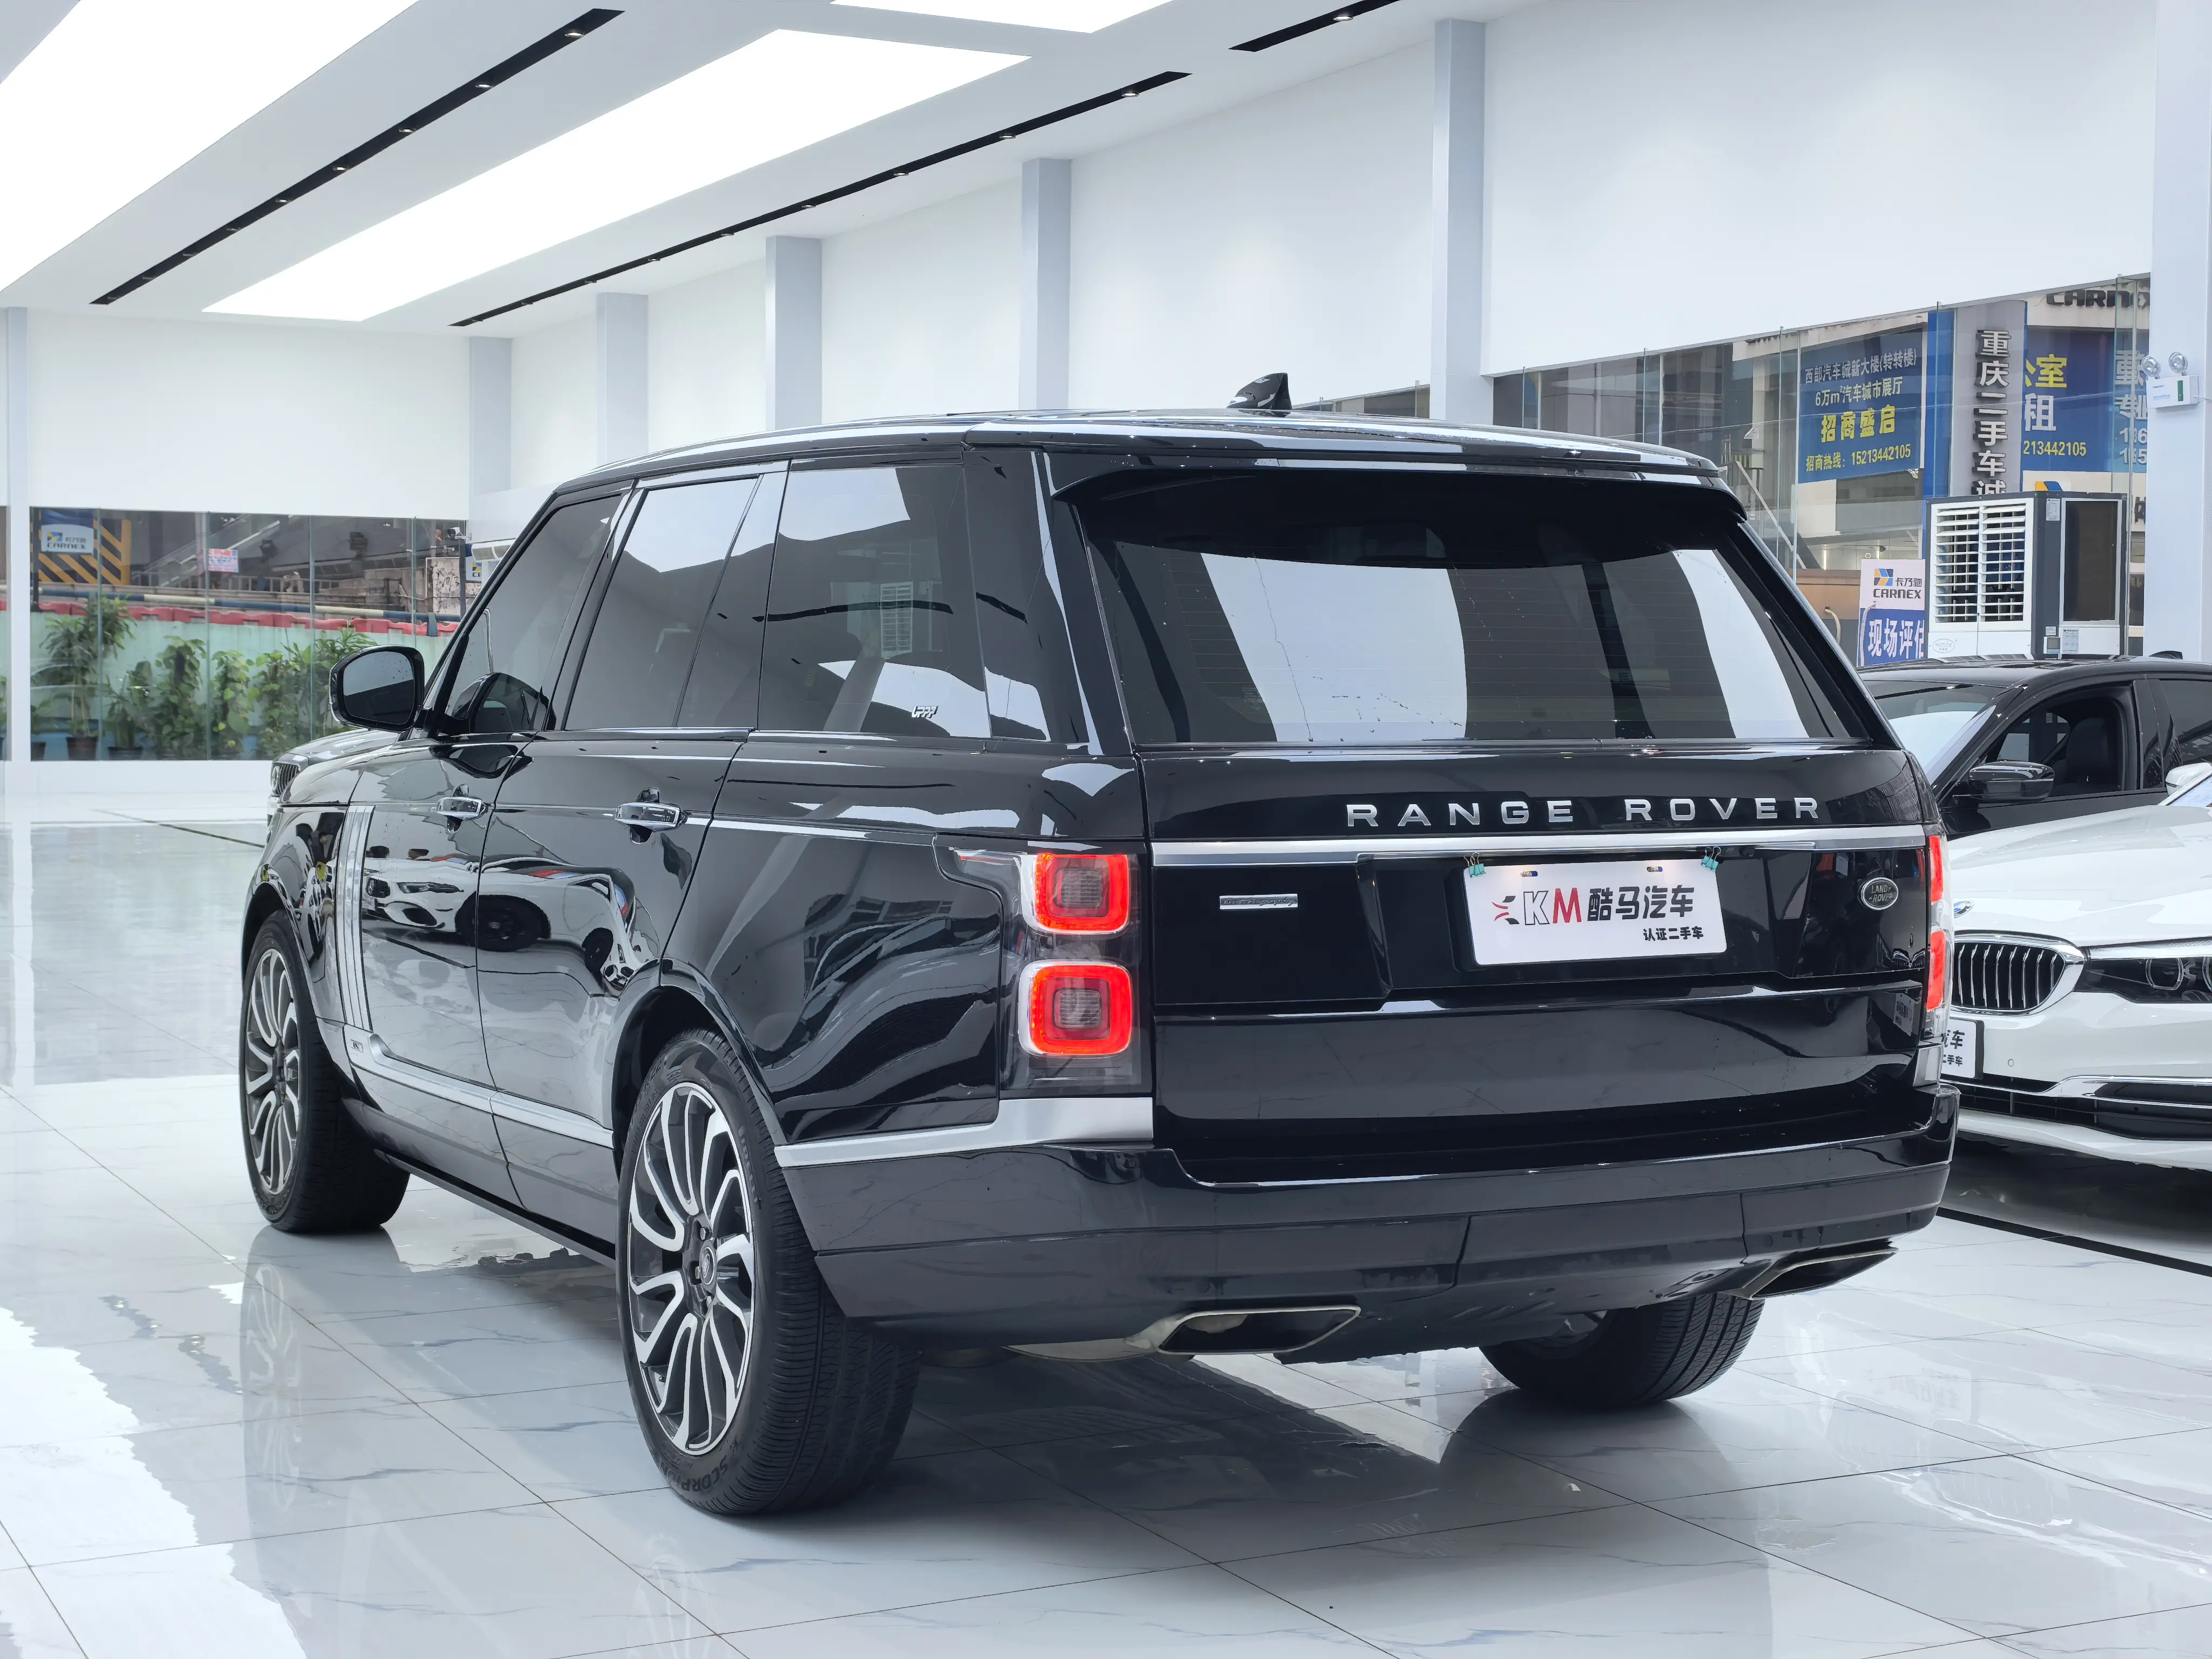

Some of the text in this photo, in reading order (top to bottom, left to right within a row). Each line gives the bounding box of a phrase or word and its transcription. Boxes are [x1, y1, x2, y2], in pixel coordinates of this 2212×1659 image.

[1821, 404, 1896, 443] 招商盛启
[1851, 443, 1911, 466] 15213442105
[1873, 589, 1921, 599] CARNEX
[1347, 798, 1819, 827] RANGE ROVER
[1871, 885, 1888, 894] LAND
[1872, 893, 1893, 902] ROVER
[1587, 884, 1695, 922] 酷马汽车
[1643, 926, 1704, 942] 认证二手车
